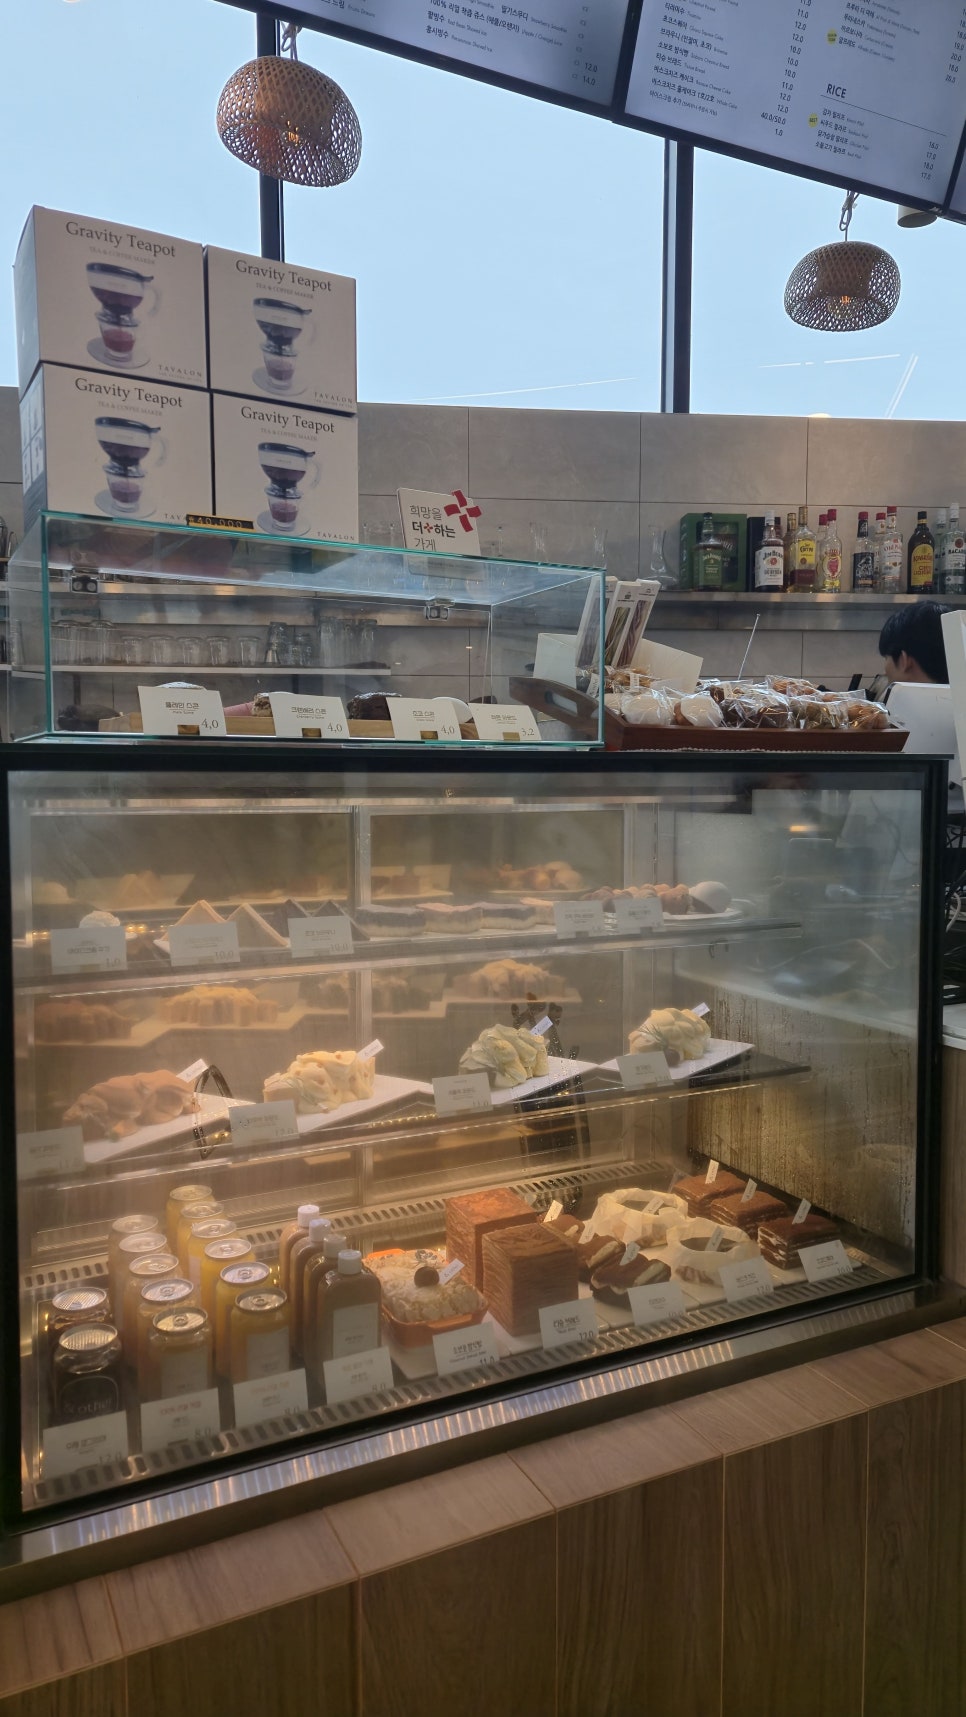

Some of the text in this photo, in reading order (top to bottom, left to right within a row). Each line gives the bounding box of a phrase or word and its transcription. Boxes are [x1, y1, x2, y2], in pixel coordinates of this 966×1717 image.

[797, 9, 809, 19] 11.0
[792, 33, 804, 43] 12.0
[584, 62, 598, 73] 12.0
[583, 75, 596, 86] 14.0
[780, 92, 791, 102] 12.0
[826, 83, 847, 99] RICE
[777, 104, 789, 114] 12.0
[65, 221, 176, 257] Gravity Teapot
[235, 259, 331, 292] Gravity Teapot
[158, 364, 203, 378] TAVALON
[75, 377, 182, 408] Gravity Teapot
[241, 406, 334, 434] Gravity Teapot
[410, 505, 442, 521] 희망을
[318, 531, 354, 541] TAVALON
[415, 538, 436, 552] 가게
